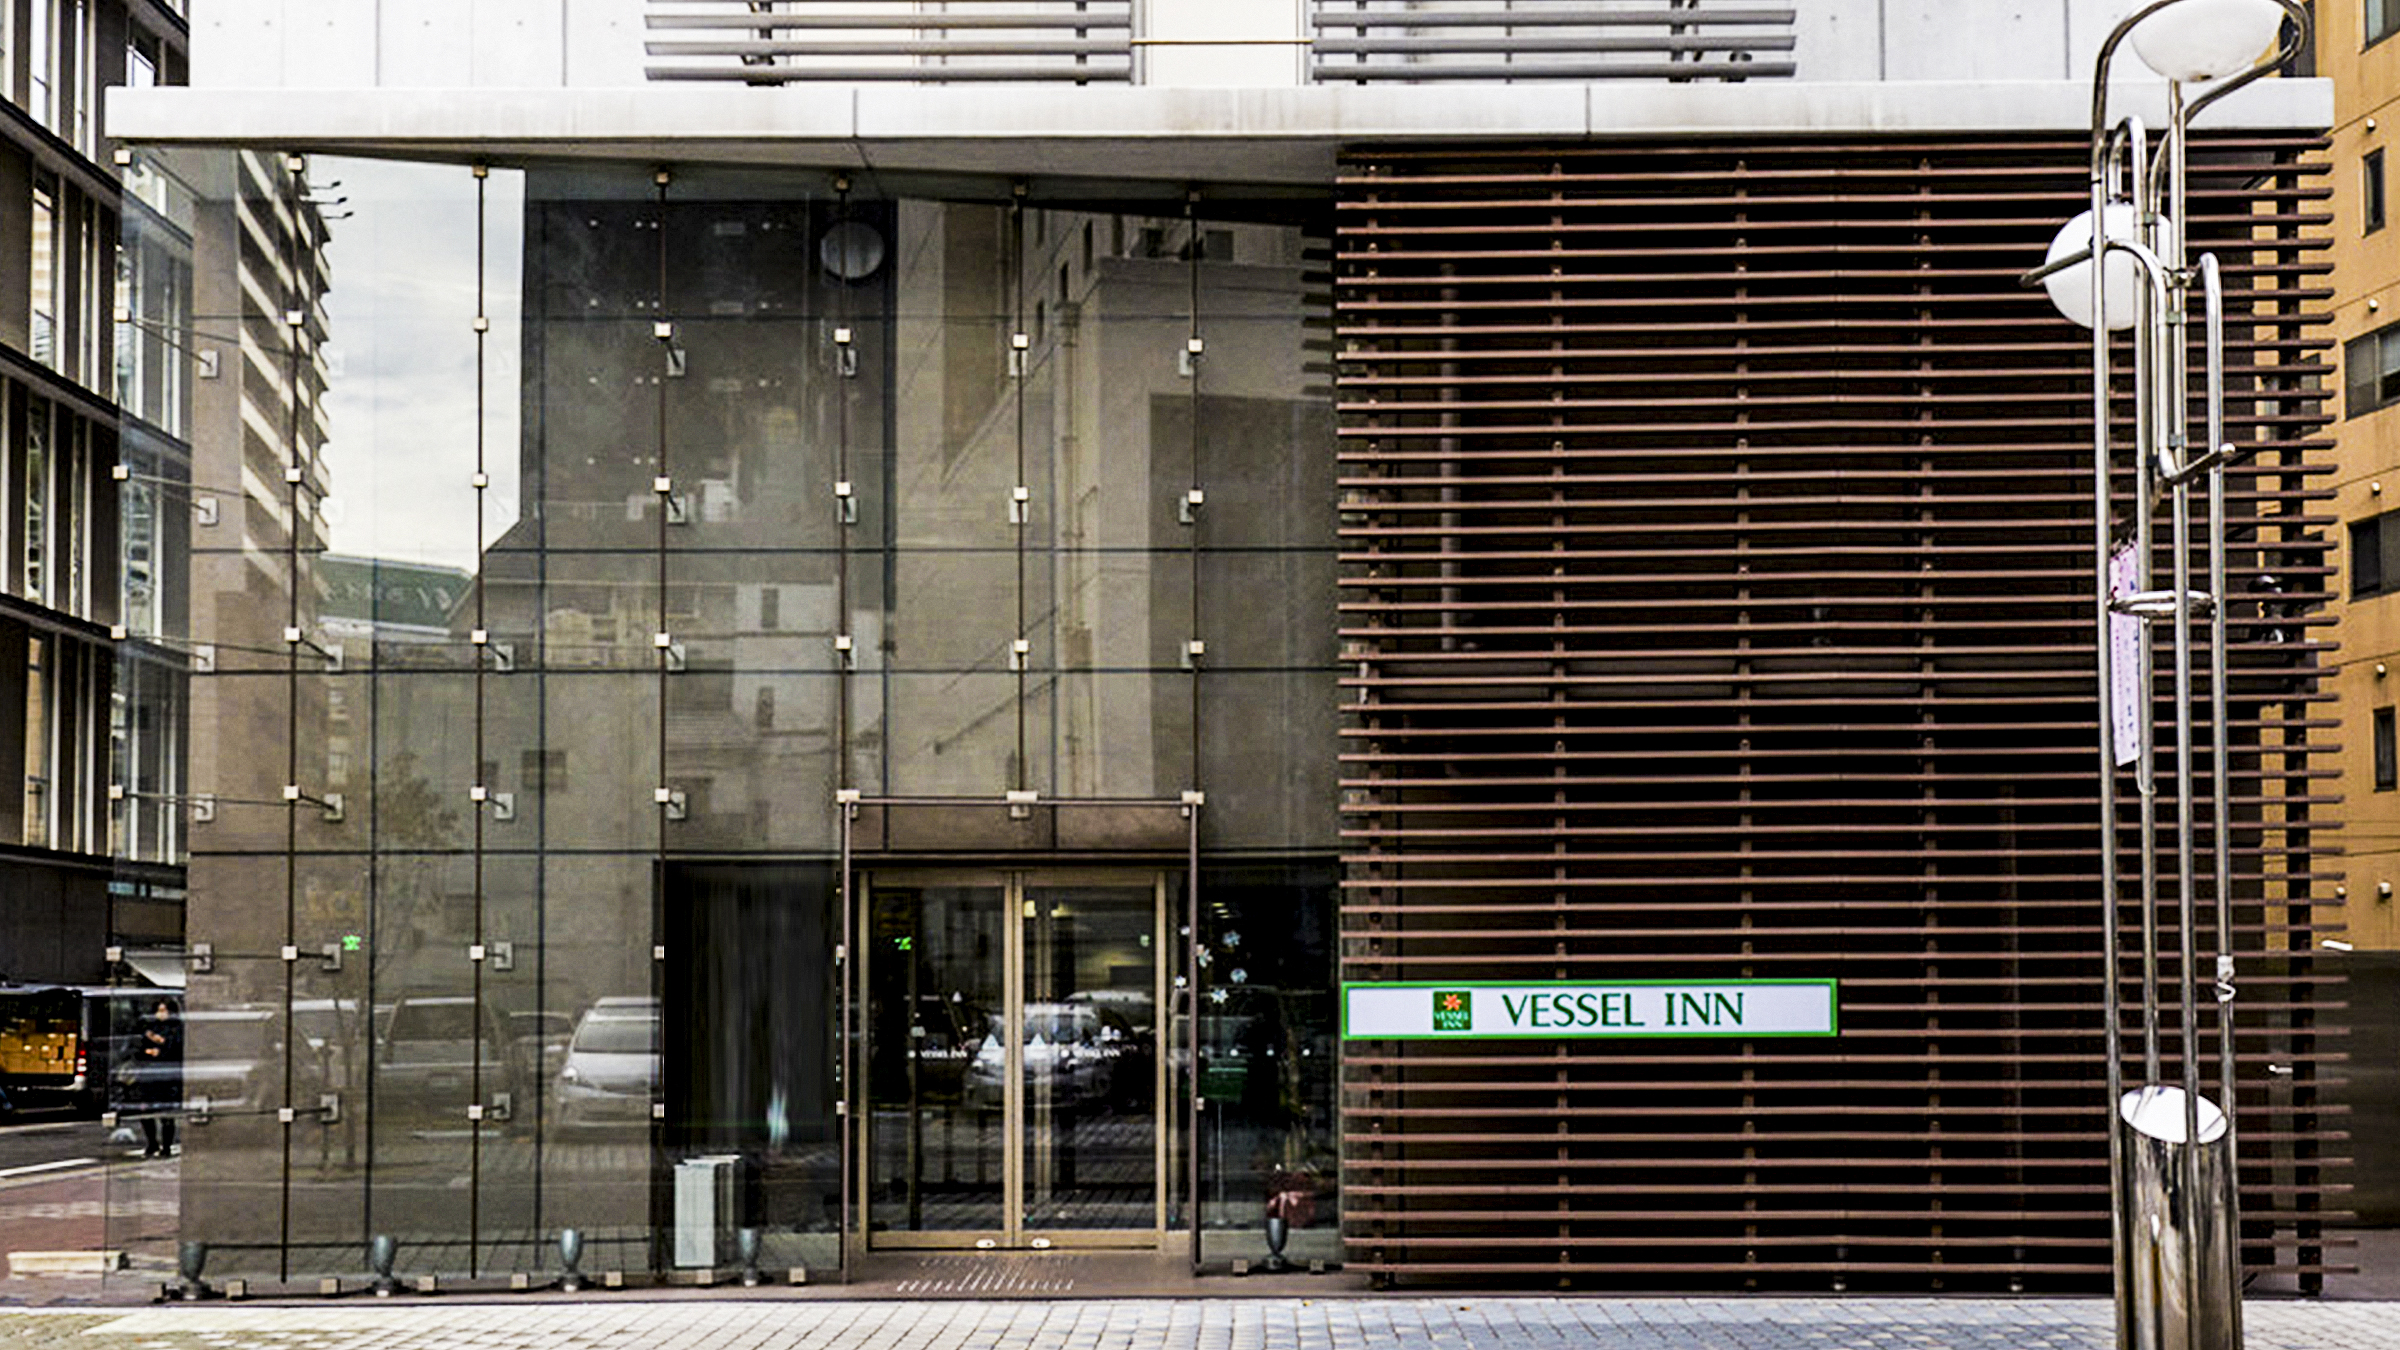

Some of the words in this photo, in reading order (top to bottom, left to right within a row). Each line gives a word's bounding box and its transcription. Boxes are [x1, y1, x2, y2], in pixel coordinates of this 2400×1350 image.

[1502, 993, 1646, 1027] VESSEL
[1664, 992, 1744, 1026] INN
[1442, 1020, 1462, 1028] INN
